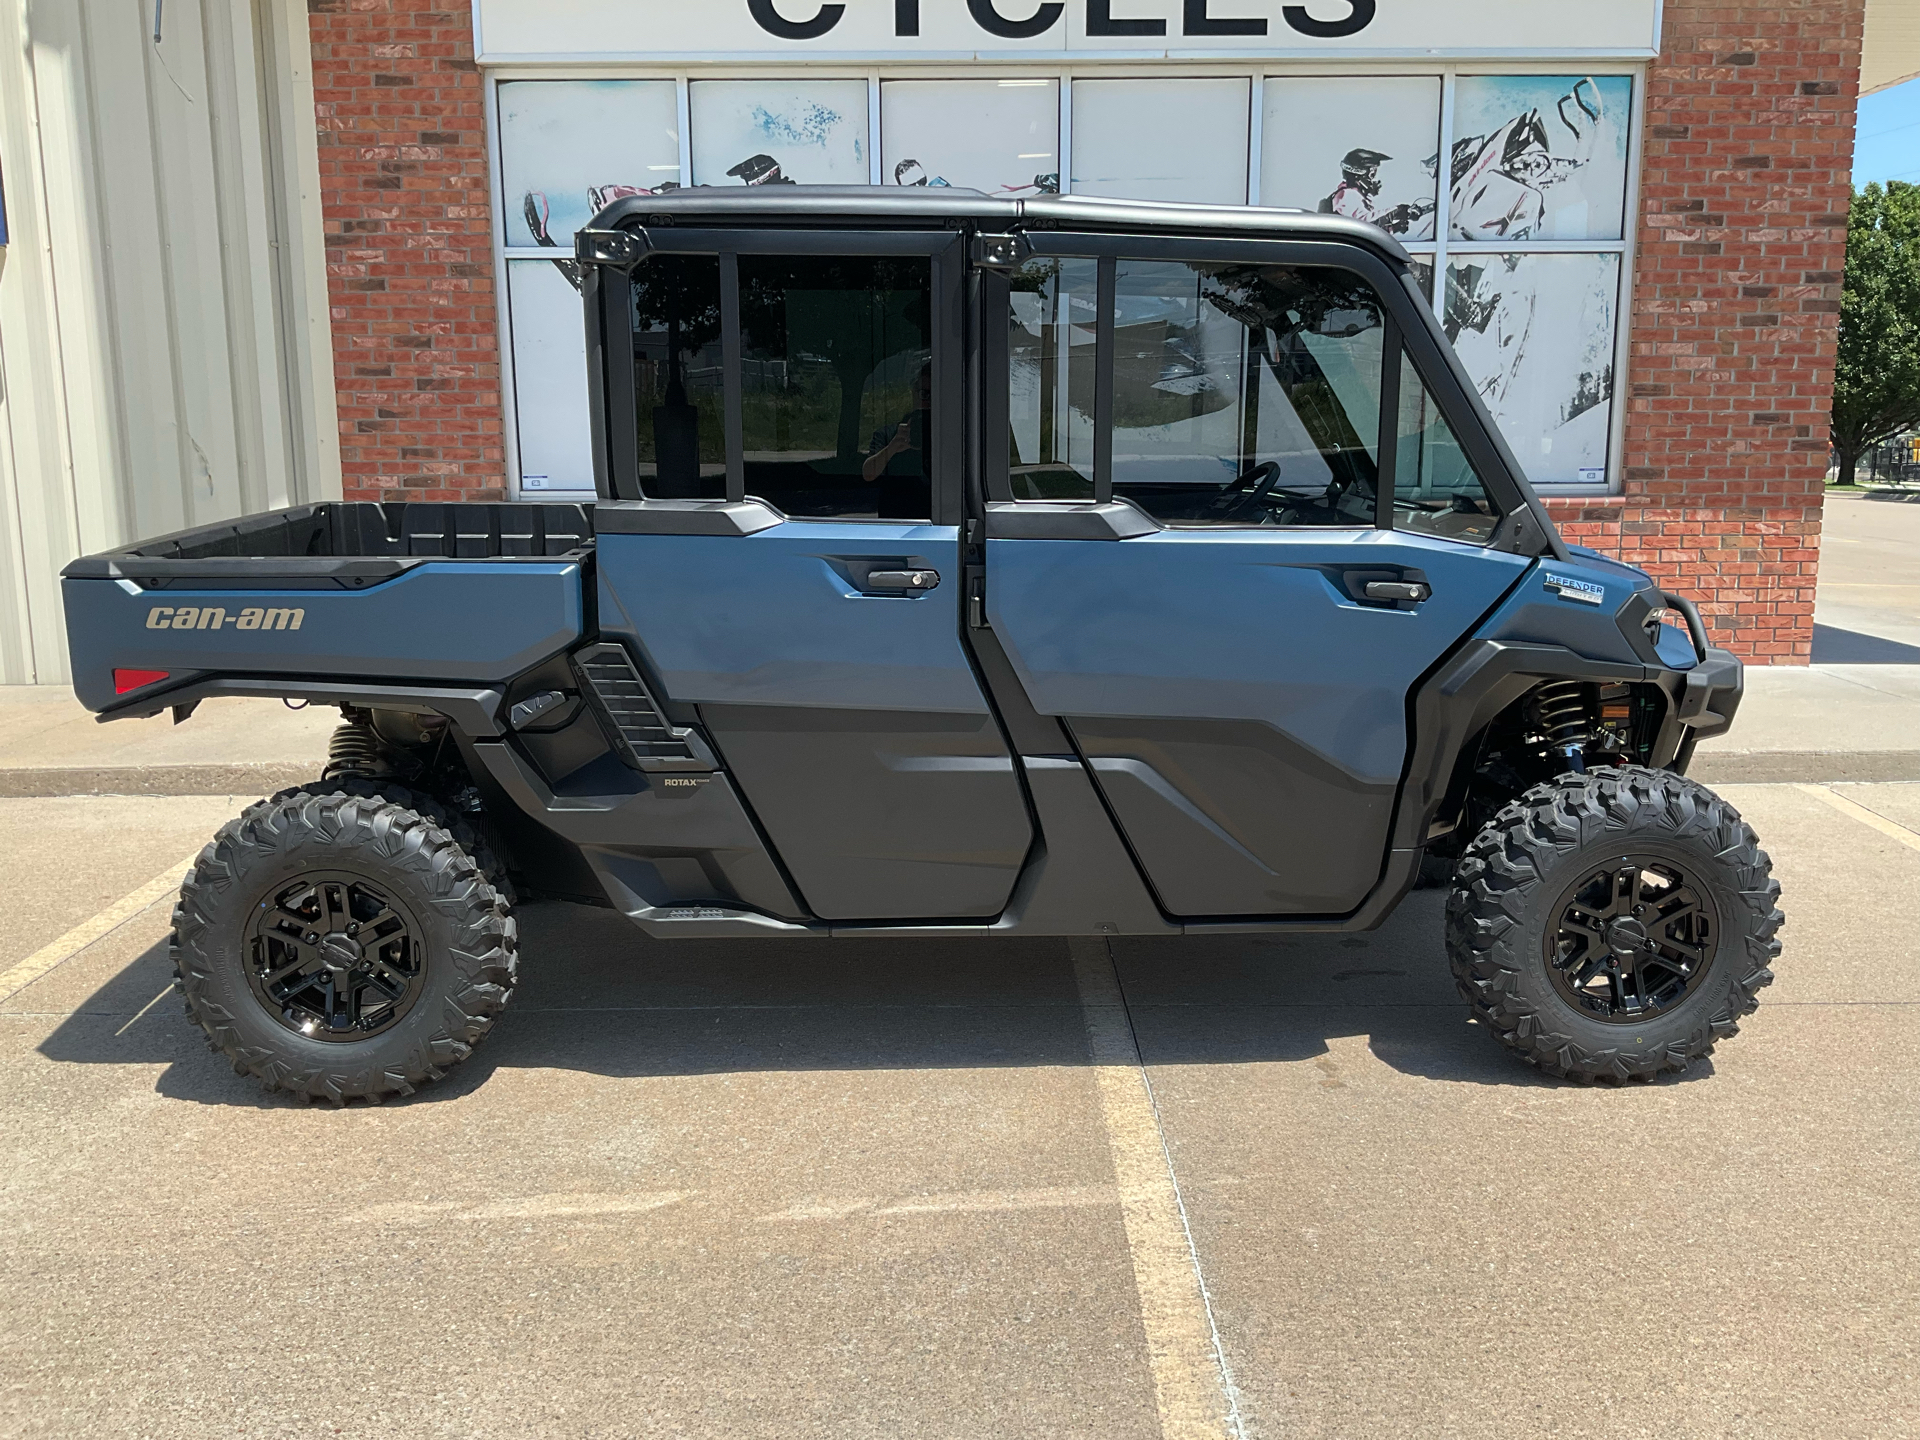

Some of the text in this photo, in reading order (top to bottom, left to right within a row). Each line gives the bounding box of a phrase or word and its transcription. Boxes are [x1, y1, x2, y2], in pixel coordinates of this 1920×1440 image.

[1548, 575, 1603, 594] DEFENDER
[145, 607, 305, 630] can-am
[664, 779, 697, 787] ROTAX
